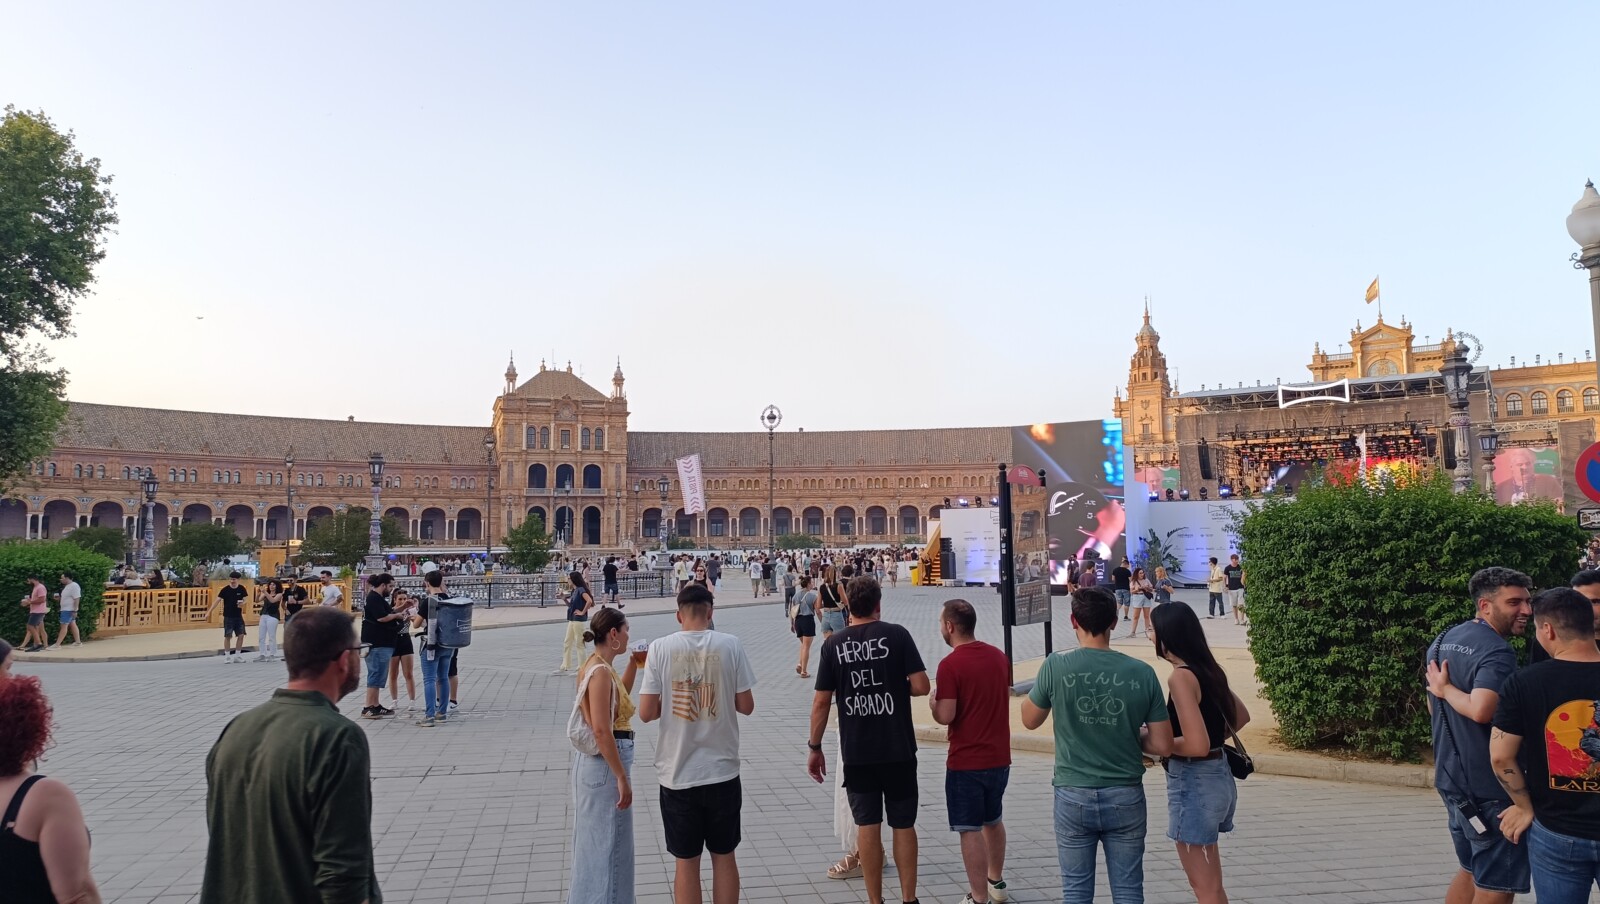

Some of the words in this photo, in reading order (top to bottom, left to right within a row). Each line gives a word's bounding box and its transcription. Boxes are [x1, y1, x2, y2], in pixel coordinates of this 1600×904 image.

[836, 636, 890, 665] HÉROES
[850, 668, 884, 689] DEL
[1062, 671, 1141, 691] じてんしゃ
[845, 691, 895, 717] SÁBADO
[1079, 714, 1118, 726] BICYCLE
[1551, 777, 1600, 791] LAR
